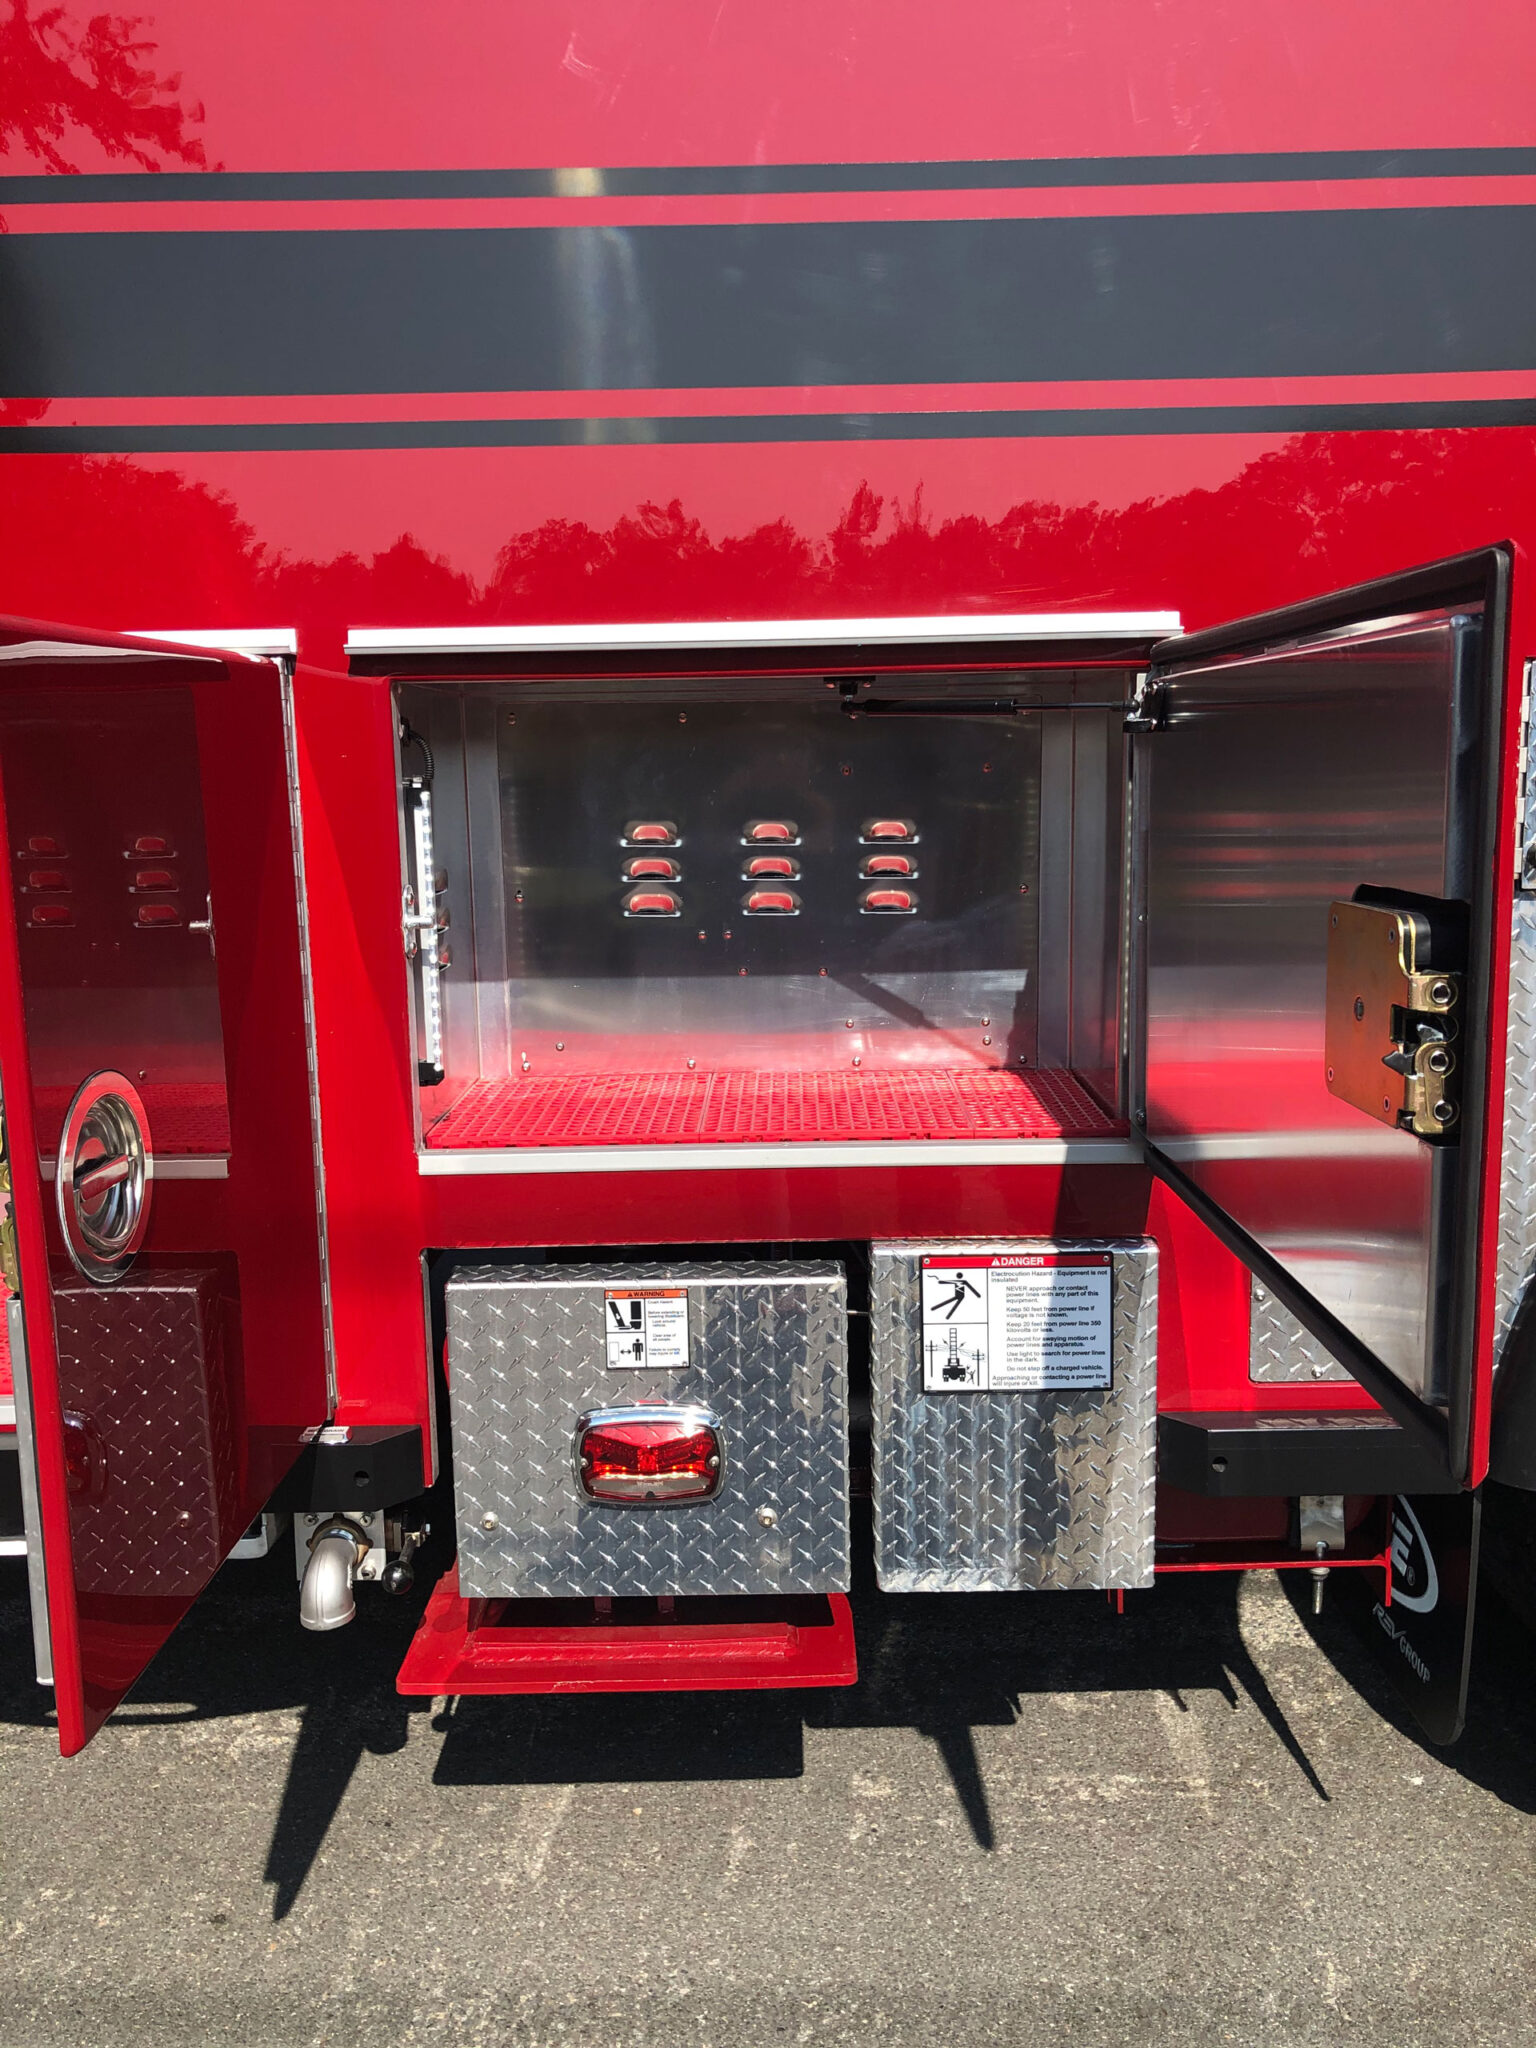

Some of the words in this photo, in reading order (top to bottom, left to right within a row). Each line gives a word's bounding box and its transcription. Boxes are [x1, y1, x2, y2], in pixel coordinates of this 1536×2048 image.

[1001, 1257, 1044, 1265] DANGER
[1372, 1602, 1406, 1640] REV
[1400, 1636, 1431, 1684] GROUP
